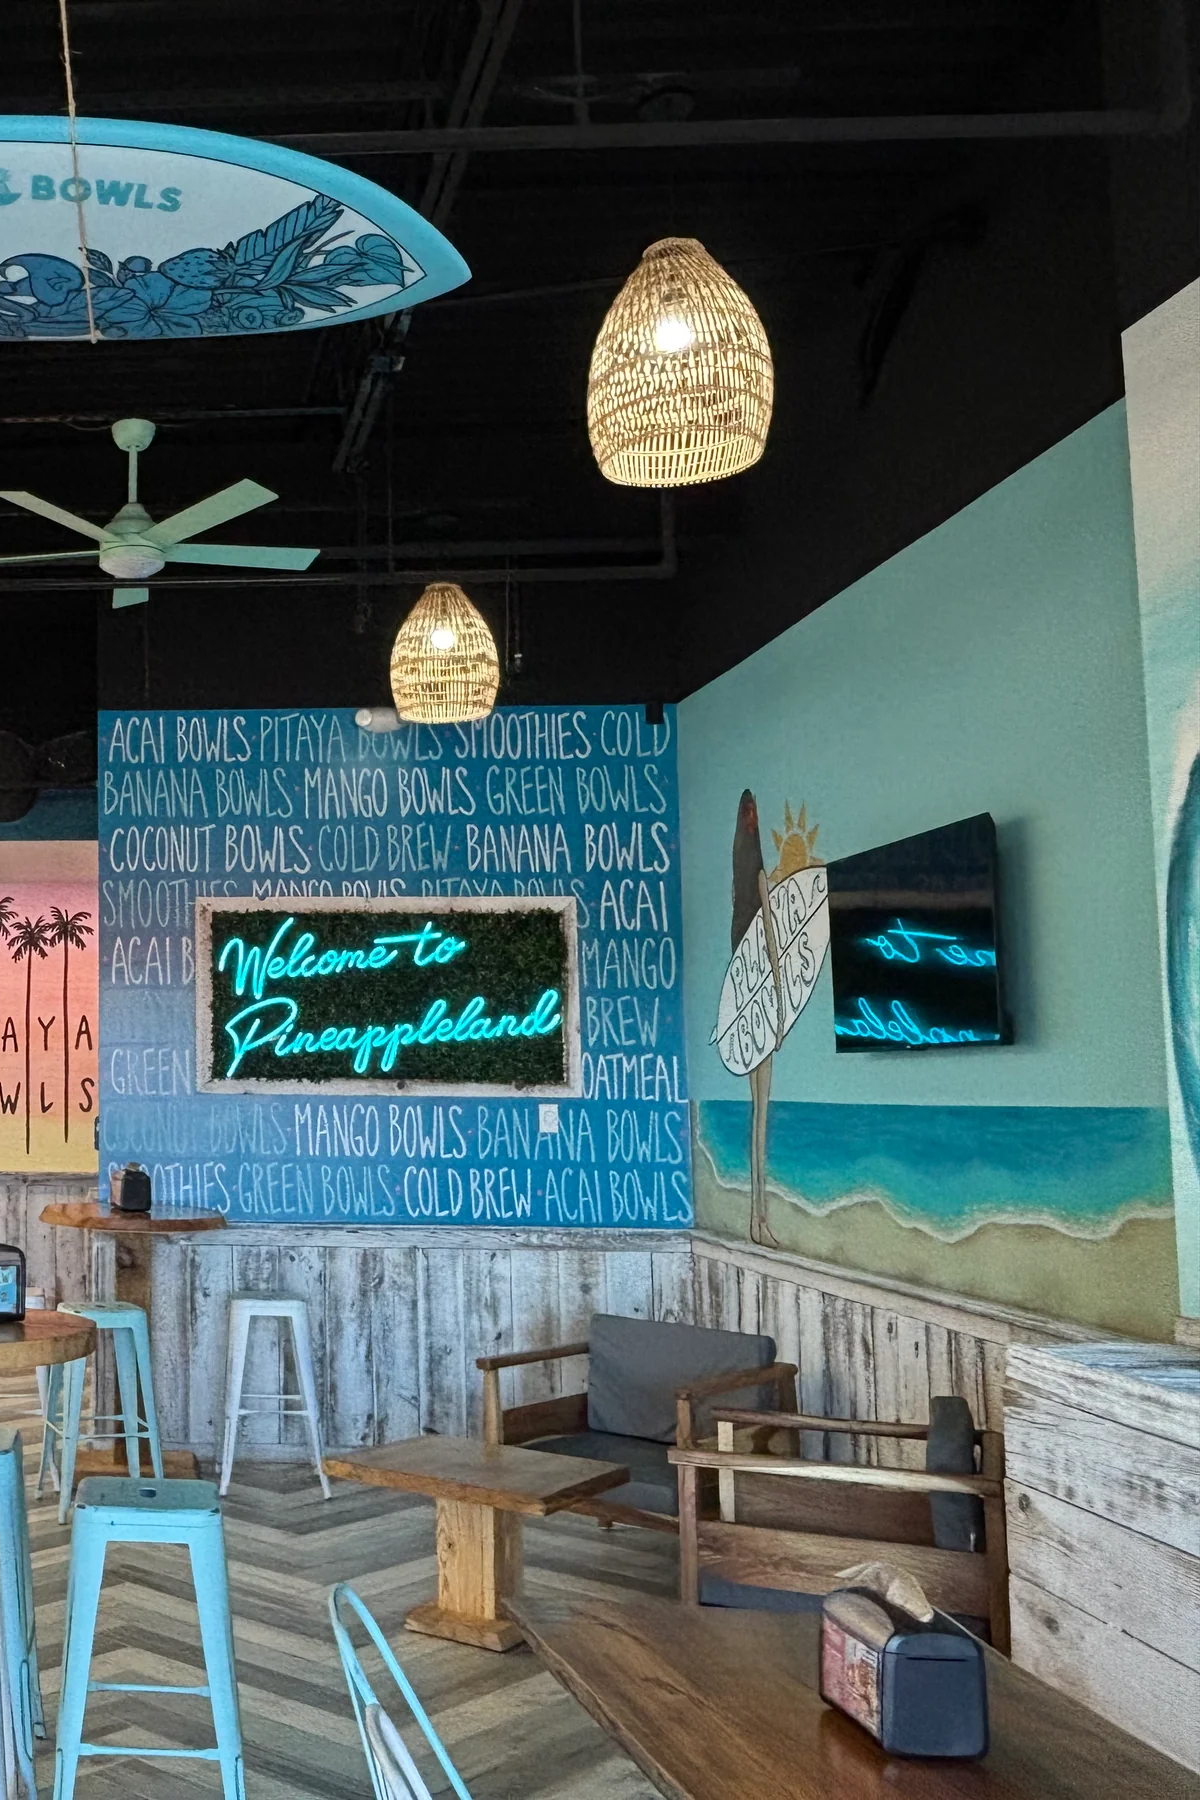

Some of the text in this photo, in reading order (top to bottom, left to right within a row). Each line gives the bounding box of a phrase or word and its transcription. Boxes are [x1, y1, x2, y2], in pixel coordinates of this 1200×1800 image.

[31, 174, 182, 212] BOWLS
[108, 715, 165, 764] ACAI
[177, 715, 252, 763] BOWLS
[260, 712, 346, 764] PITAYA
[454, 710, 592, 760] SMOOTHIES
[600, 710, 671, 758] COLD
[103, 764, 667, 819] BANANA BOWLS MANGO BOWLS GREEN BOWLS
[109, 821, 671, 874] COCONUT BOWLS COLD BREW BANANA BOWLS
[600, 878, 668, 931] ACAI
[111, 935, 172, 985] ACAI
[218, 917, 398, 999] Welcome
[374, 921, 466, 966] to
[582, 937, 676, 990] MANGO
[225, 989, 562, 1077] Pineappleland
[586, 995, 660, 1047] BREW
[111, 1048, 192, 1095] GREEN
[582, 1052, 689, 1103] OATMEAL
[210, 1102, 288, 1154] BOWLS
[294, 1102, 380, 1157] MANGO
[389, 1103, 467, 1158] BOWLS
[607, 1108, 683, 1164] BOWLS
[238, 1162, 315, 1215] GREEN
[322, 1163, 396, 1217] BOWLS
[404, 1166, 463, 1218] COLD
[469, 1167, 532, 1219] BREW
[545, 1166, 601, 1223] ACAI
[609, 1168, 694, 1223] BOWLS
